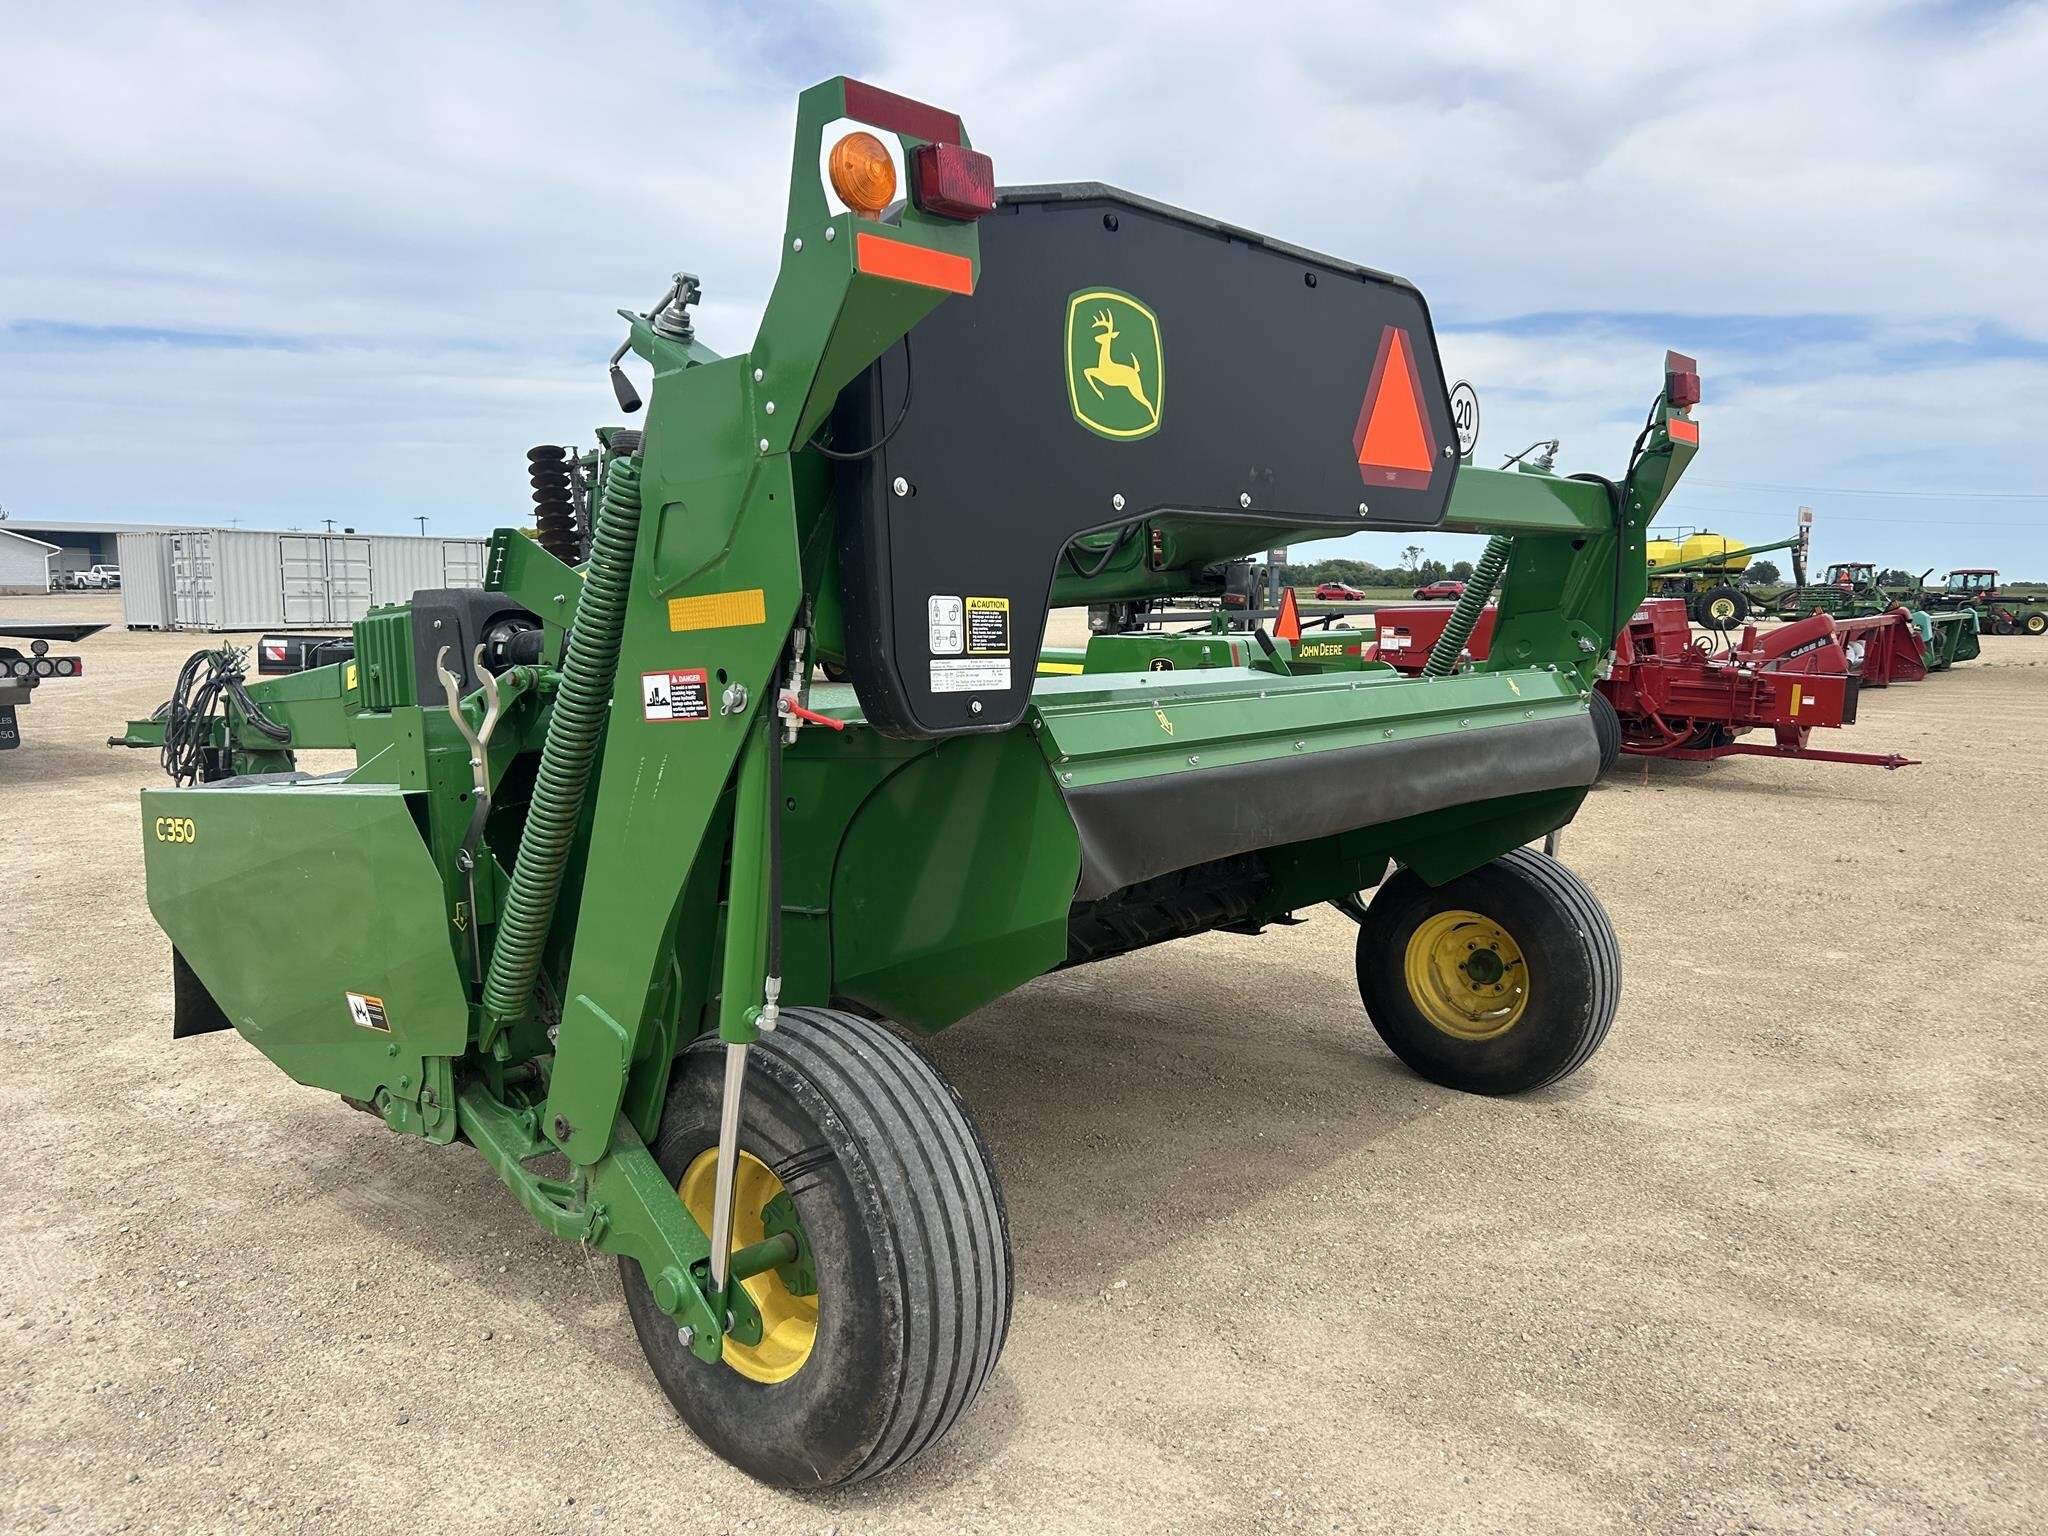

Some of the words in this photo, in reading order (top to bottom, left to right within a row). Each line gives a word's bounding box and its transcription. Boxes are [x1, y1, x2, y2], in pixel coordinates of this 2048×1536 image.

[1455, 399, 1471, 430] 20
[977, 600, 1004, 608] CAUTION
[1299, 644, 1319, 657] JOHN
[1319, 643, 1343, 656] DEERE
[1790, 642, 1816, 657] CASE
[157, 817, 196, 844] C350
